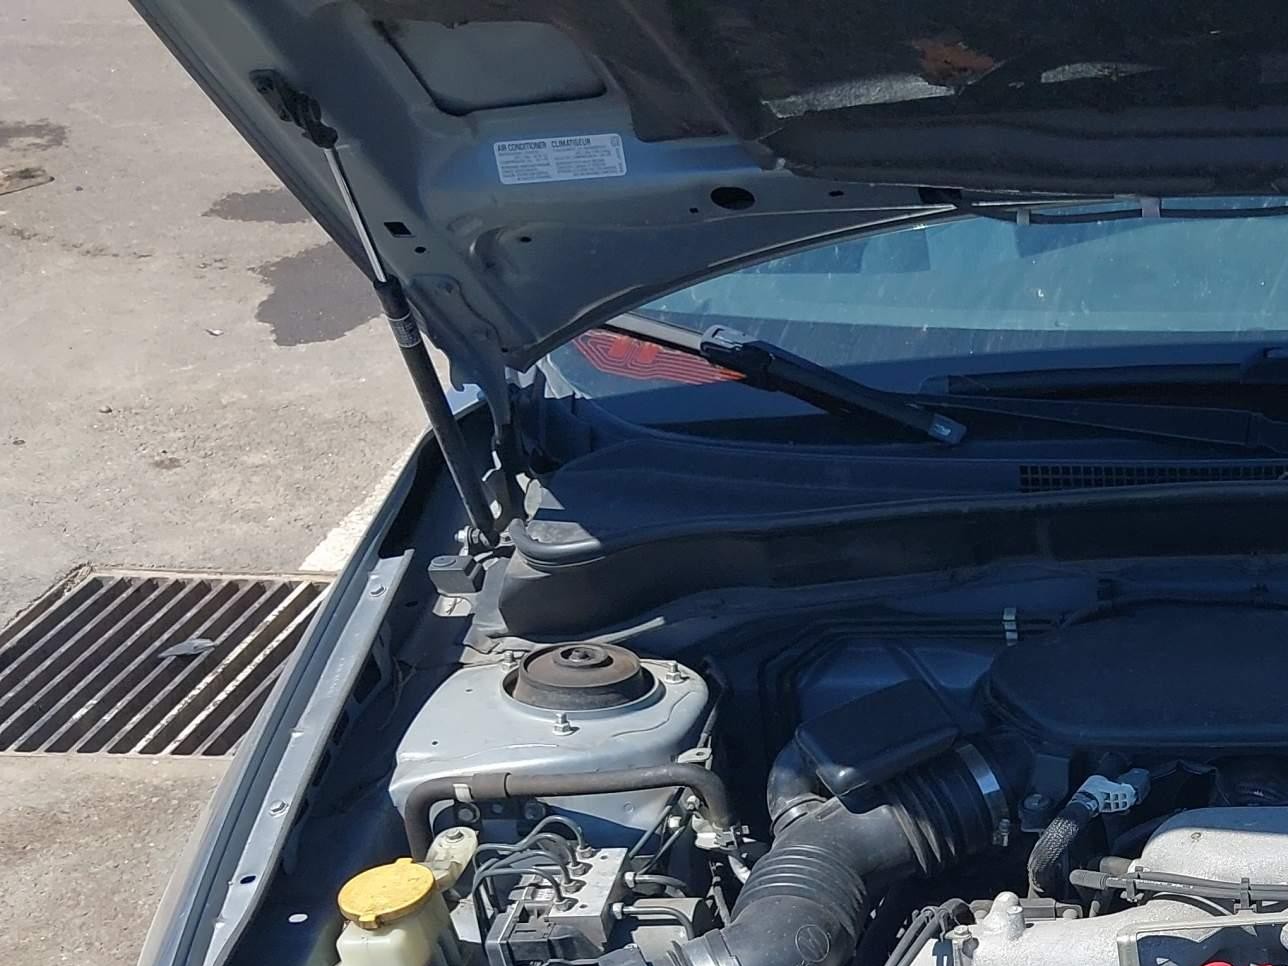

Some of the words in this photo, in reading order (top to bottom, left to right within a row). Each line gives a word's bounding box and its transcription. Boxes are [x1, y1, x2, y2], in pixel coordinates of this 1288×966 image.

[497, 143, 507, 152] AIR
[508, 141, 547, 152] CONDITIONER
[551, 138, 591, 149] CLIMATISEUR
